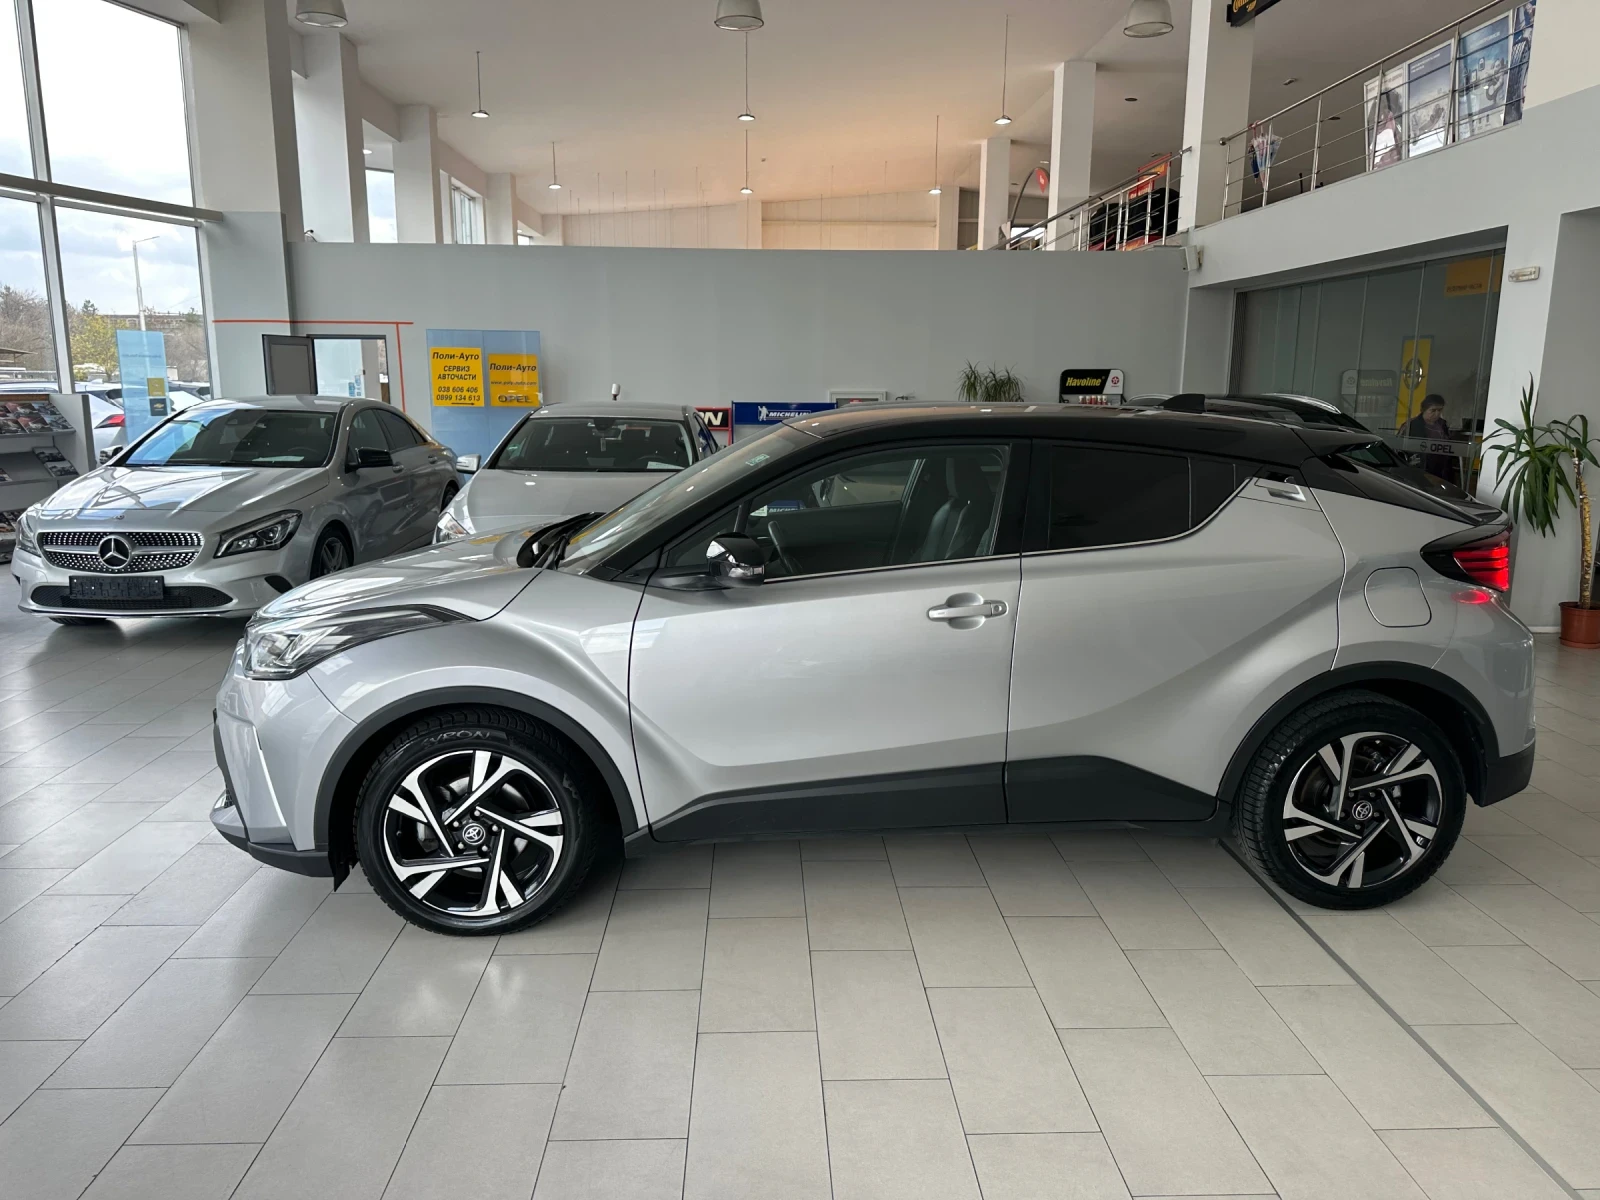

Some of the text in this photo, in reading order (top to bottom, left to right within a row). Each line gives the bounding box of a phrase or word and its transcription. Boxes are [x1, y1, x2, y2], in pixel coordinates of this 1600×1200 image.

[432, 352, 480, 361] Поли-Ауто
[489, 363, 537, 372] Поли-Ауто
[437, 373, 477, 381] АВТОЧАСТИ
[1066, 377, 1102, 387] Havoline
[498, 394, 533, 403] OPEL
[1430, 443, 1455, 454] OPEL
